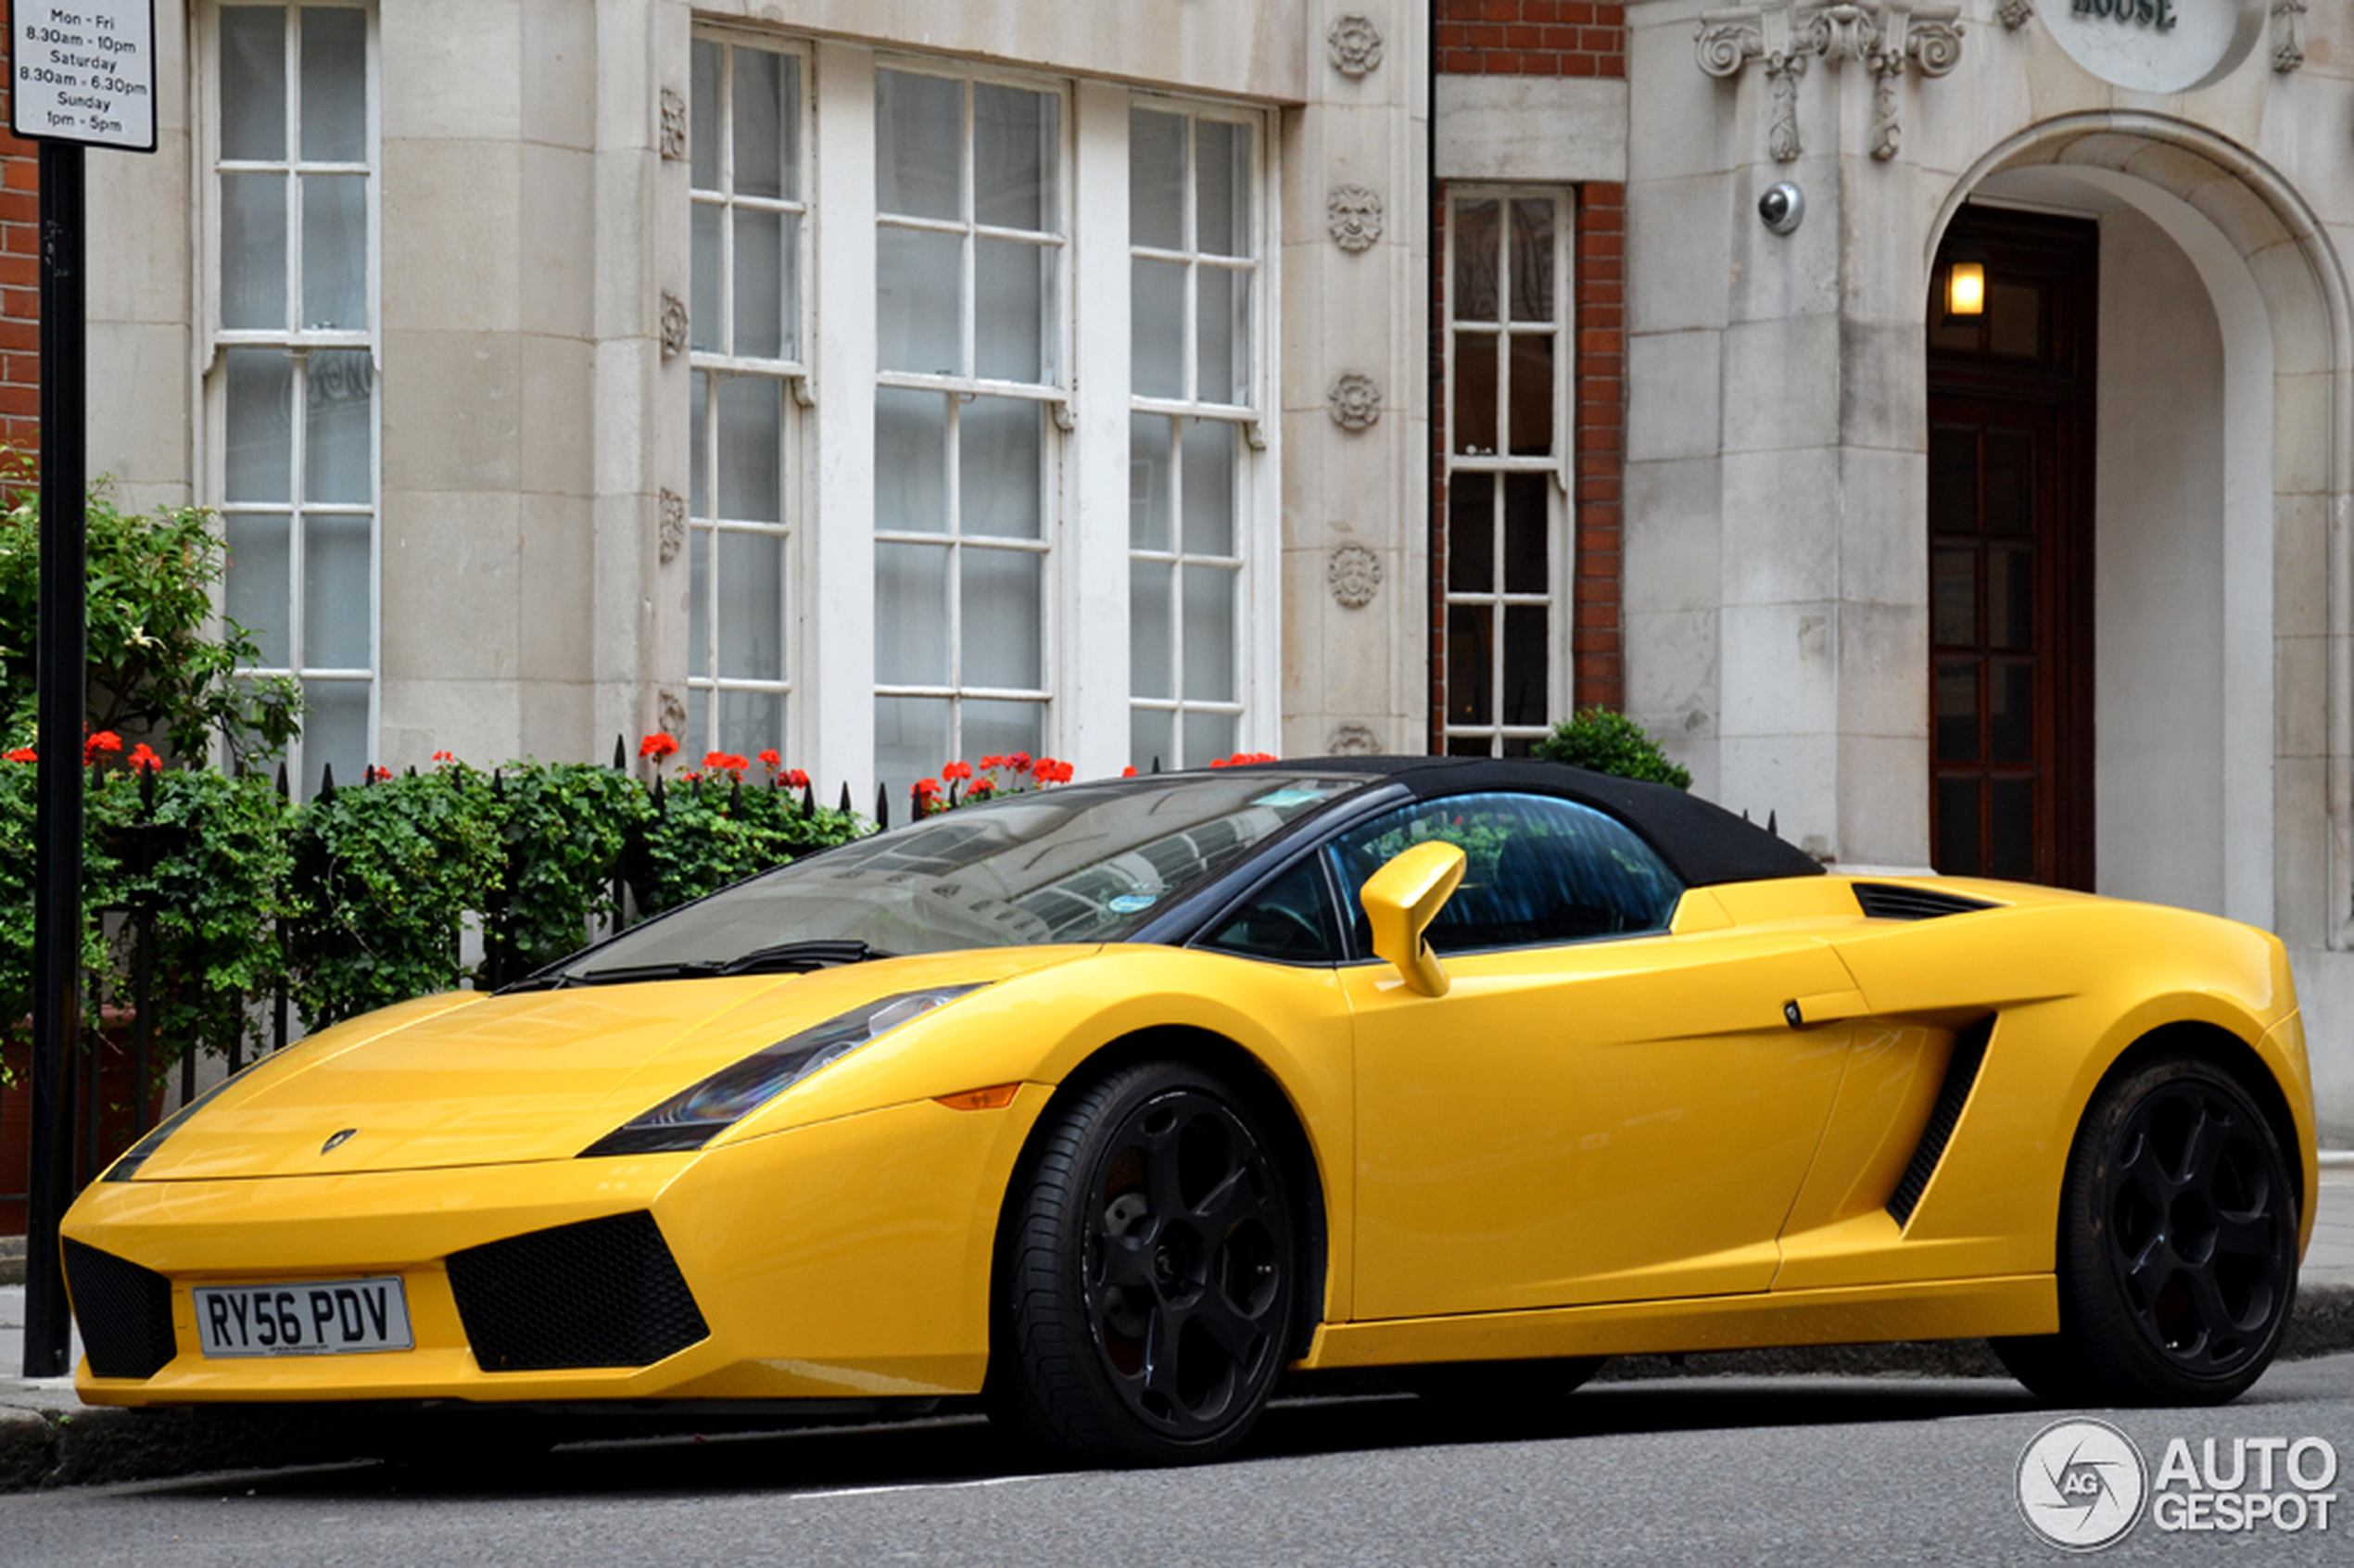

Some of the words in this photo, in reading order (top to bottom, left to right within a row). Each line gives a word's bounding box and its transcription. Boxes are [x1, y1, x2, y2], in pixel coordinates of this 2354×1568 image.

[50, 8, 82, 26] Mon
[95, 15, 115, 31] Fri
[26, 25, 83, 46] 8.30am
[97, 36, 136, 54] 10pm
[50, 49, 117, 74] Saturday
[19, 66, 77, 86] 8.30am
[91, 75, 147, 96] 6.30pm
[57, 91, 111, 113] Sunday
[47, 110, 75, 127] 1pm
[90, 115, 122, 133] 5pm
[206, 1291, 302, 1347] RY56
[308, 1286, 387, 1344] PDV
